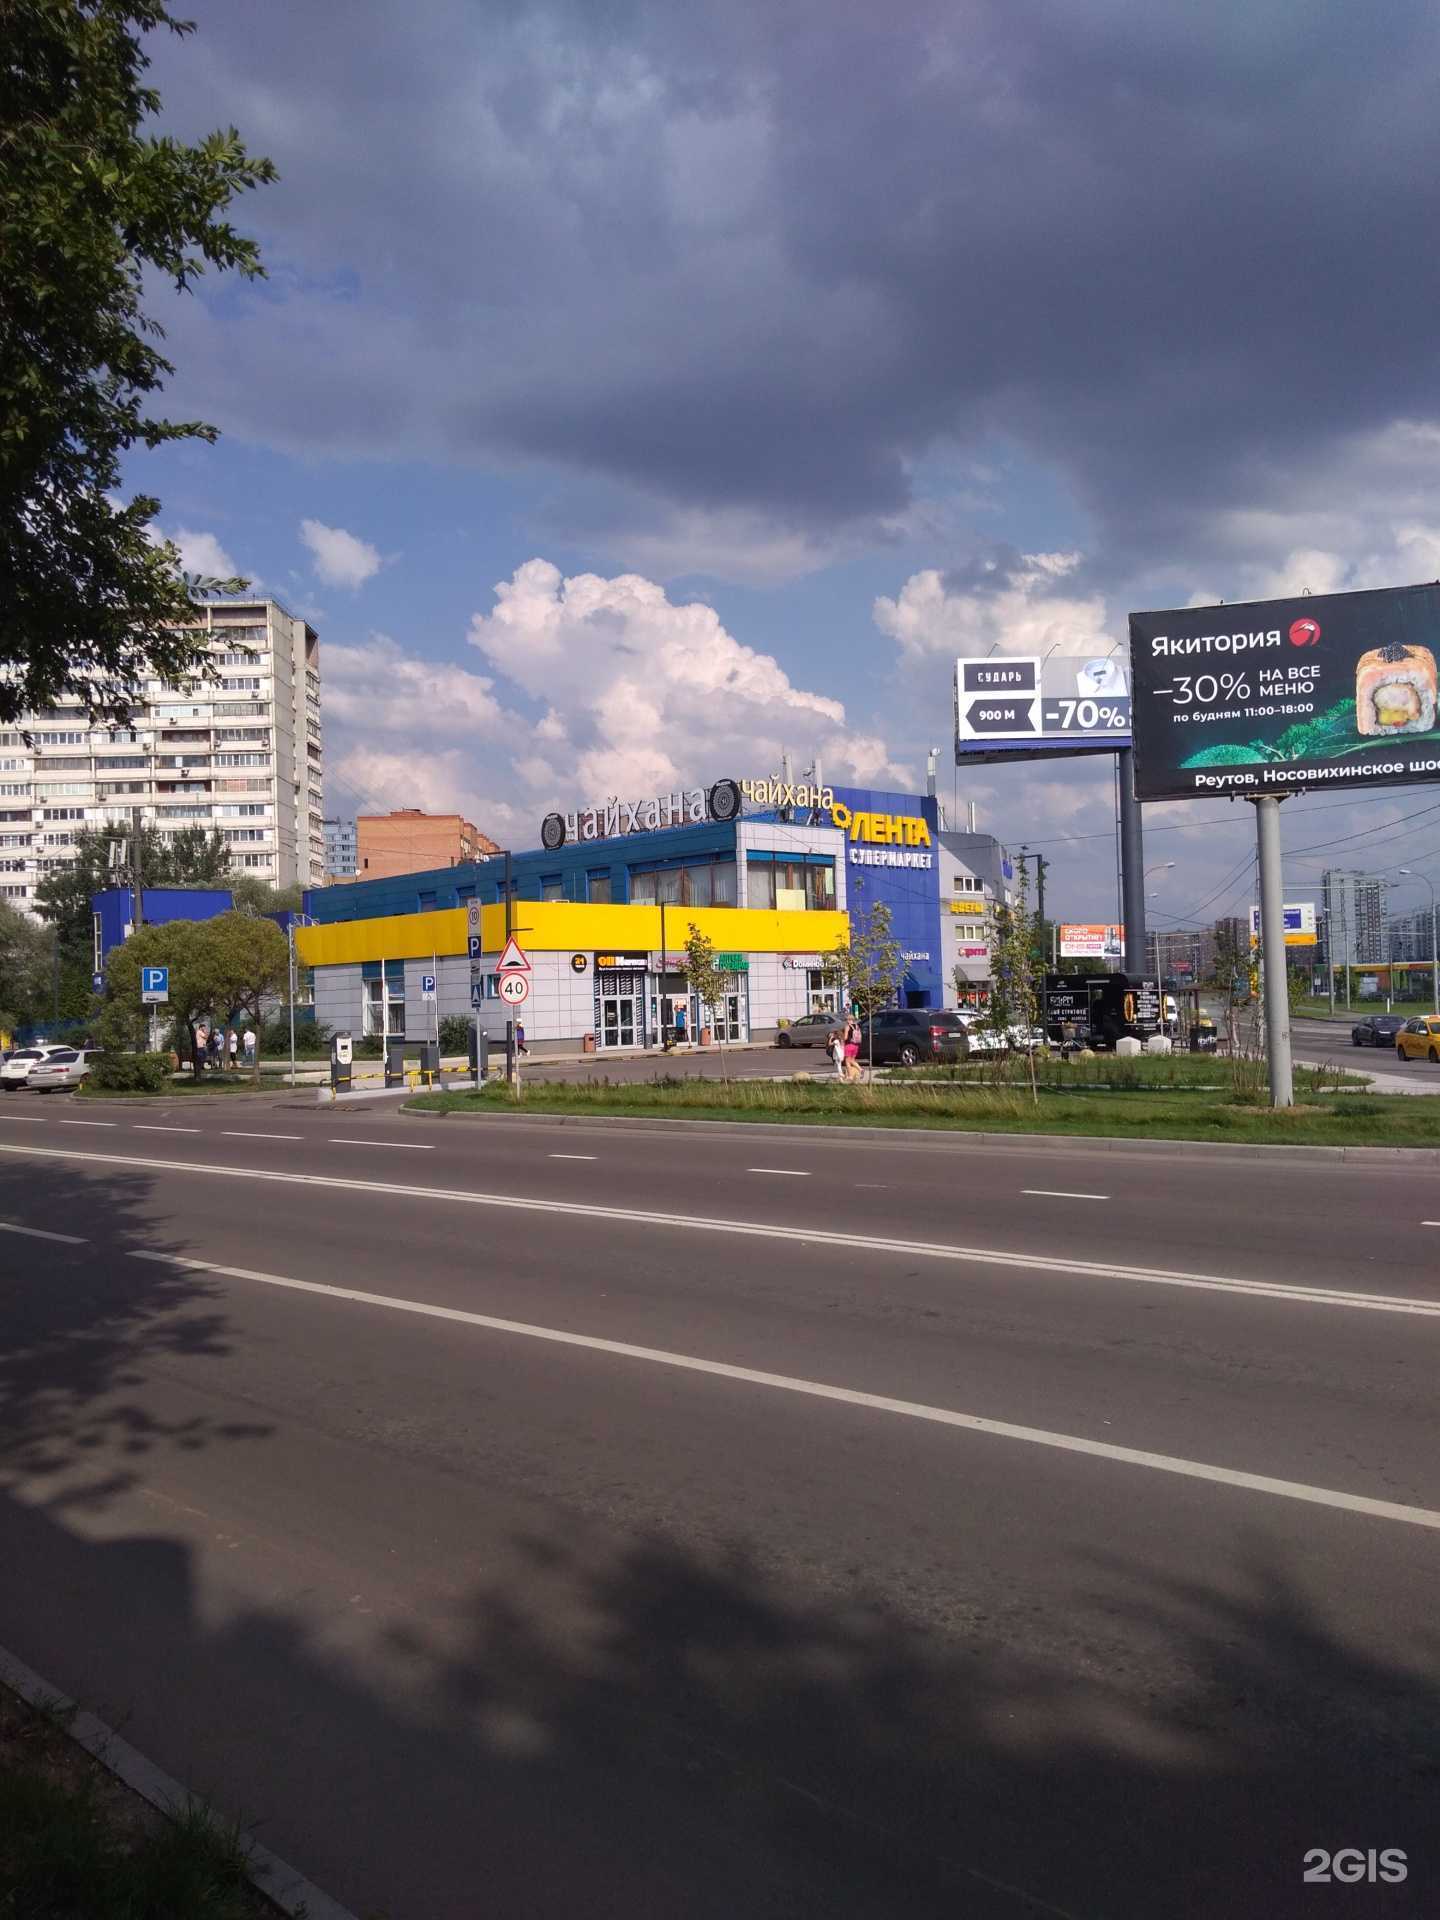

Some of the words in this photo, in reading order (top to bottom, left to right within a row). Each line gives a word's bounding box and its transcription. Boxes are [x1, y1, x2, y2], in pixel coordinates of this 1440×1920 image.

[1151, 630, 1281, 657] Якитория
[1259, 668, 1283, 682] НА
[1288, 665, 1321, 679] ВСЕ
[1259, 681, 1315, 697] МЕНЮ
[979, 710, 1000, 720] 900
[1004, 709, 1015, 720] М
[1046, 700, 1125, 729] -70%
[1173, 713, 1188, 723] по
[1192, 710, 1241, 722] будням
[1195, 772, 1259, 788] Реутов,
[1263, 761, 1404, 783] Носовихинское
[740, 774, 834, 809] чайхана
[564, 787, 708, 842] чайхана
[850, 812, 932, 848] ЛЕНТА
[849, 847, 933, 869] СУПЕРМАРКЕТ
[471, 910, 479, 919] 10
[471, 938, 480, 957] P
[149, 970, 163, 989] P
[425, 978, 434, 990] P
[504, 982, 523, 994] 40
